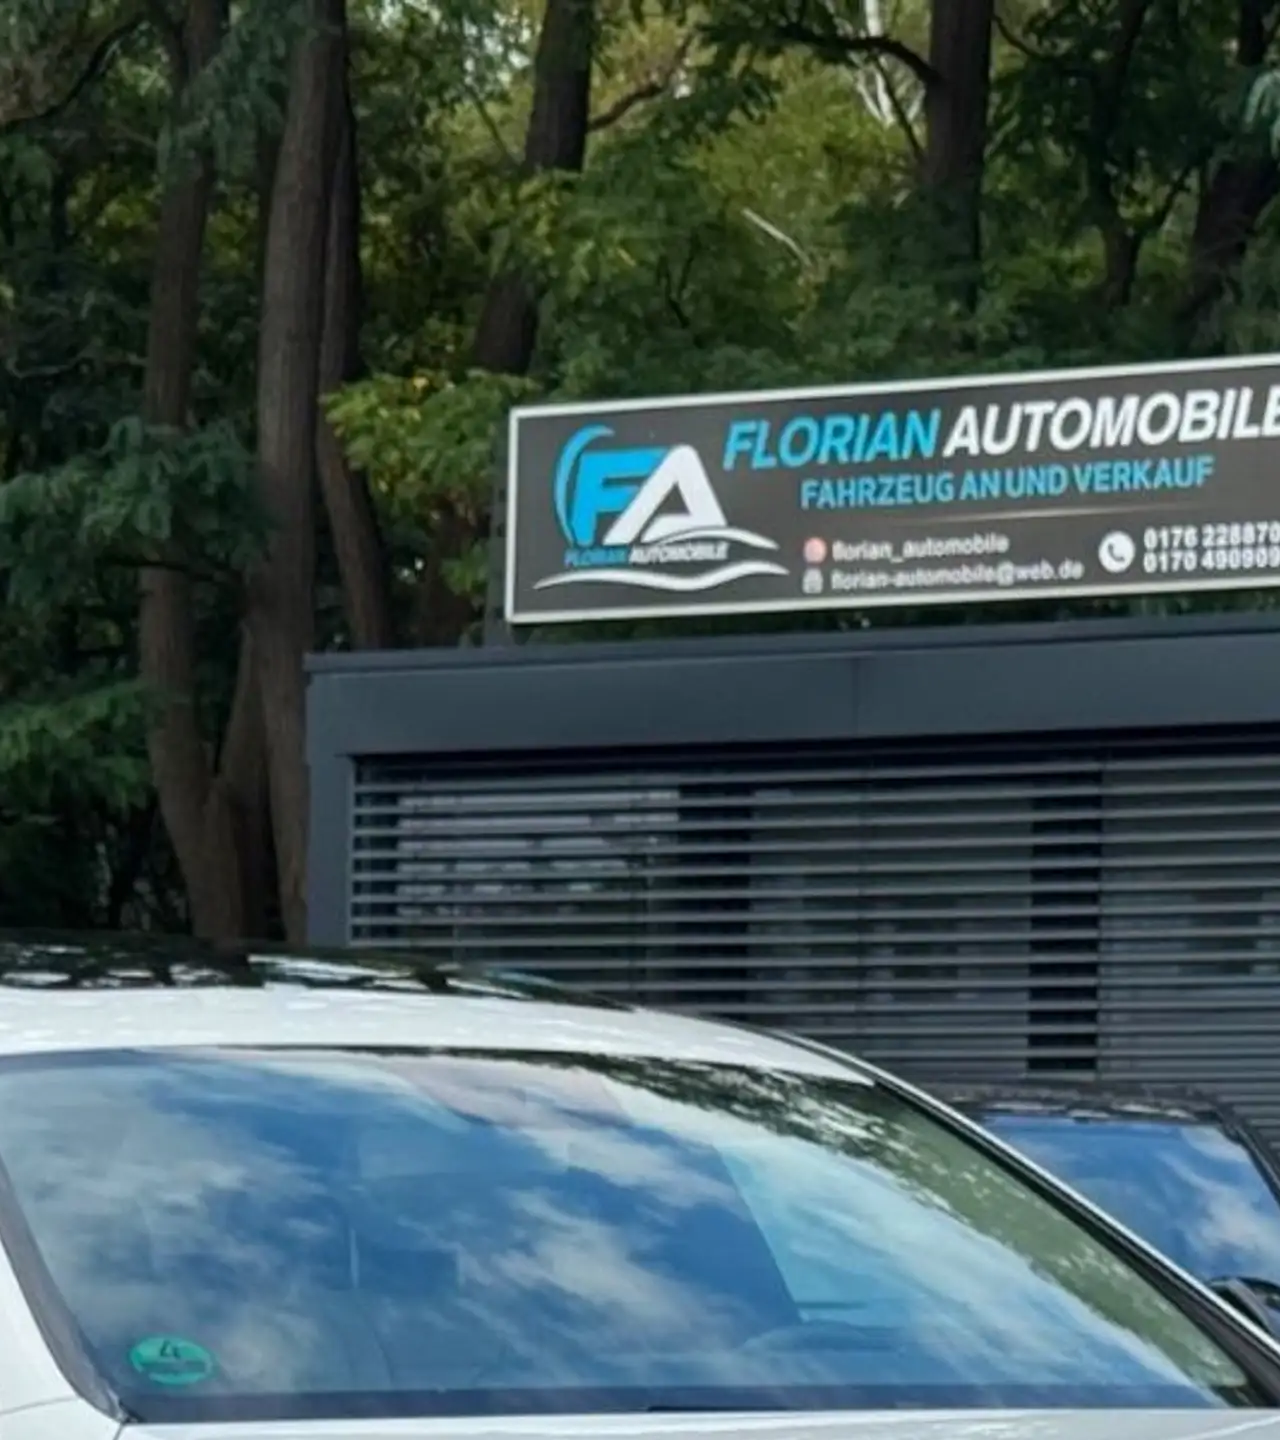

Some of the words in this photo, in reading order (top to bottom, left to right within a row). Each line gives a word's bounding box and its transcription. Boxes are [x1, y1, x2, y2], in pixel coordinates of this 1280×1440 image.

[723, 409, 941, 471] FLORIAN
[571, 444, 728, 547] FA
[801, 471, 955, 510] FAHRZEUG
[960, 468, 1002, 501] AN
[1006, 463, 1069, 497] UND
[1074, 455, 1215, 492] VERKAUF
[1143, 549, 1197, 573] 0170
[1144, 526, 1198, 550] 0176
